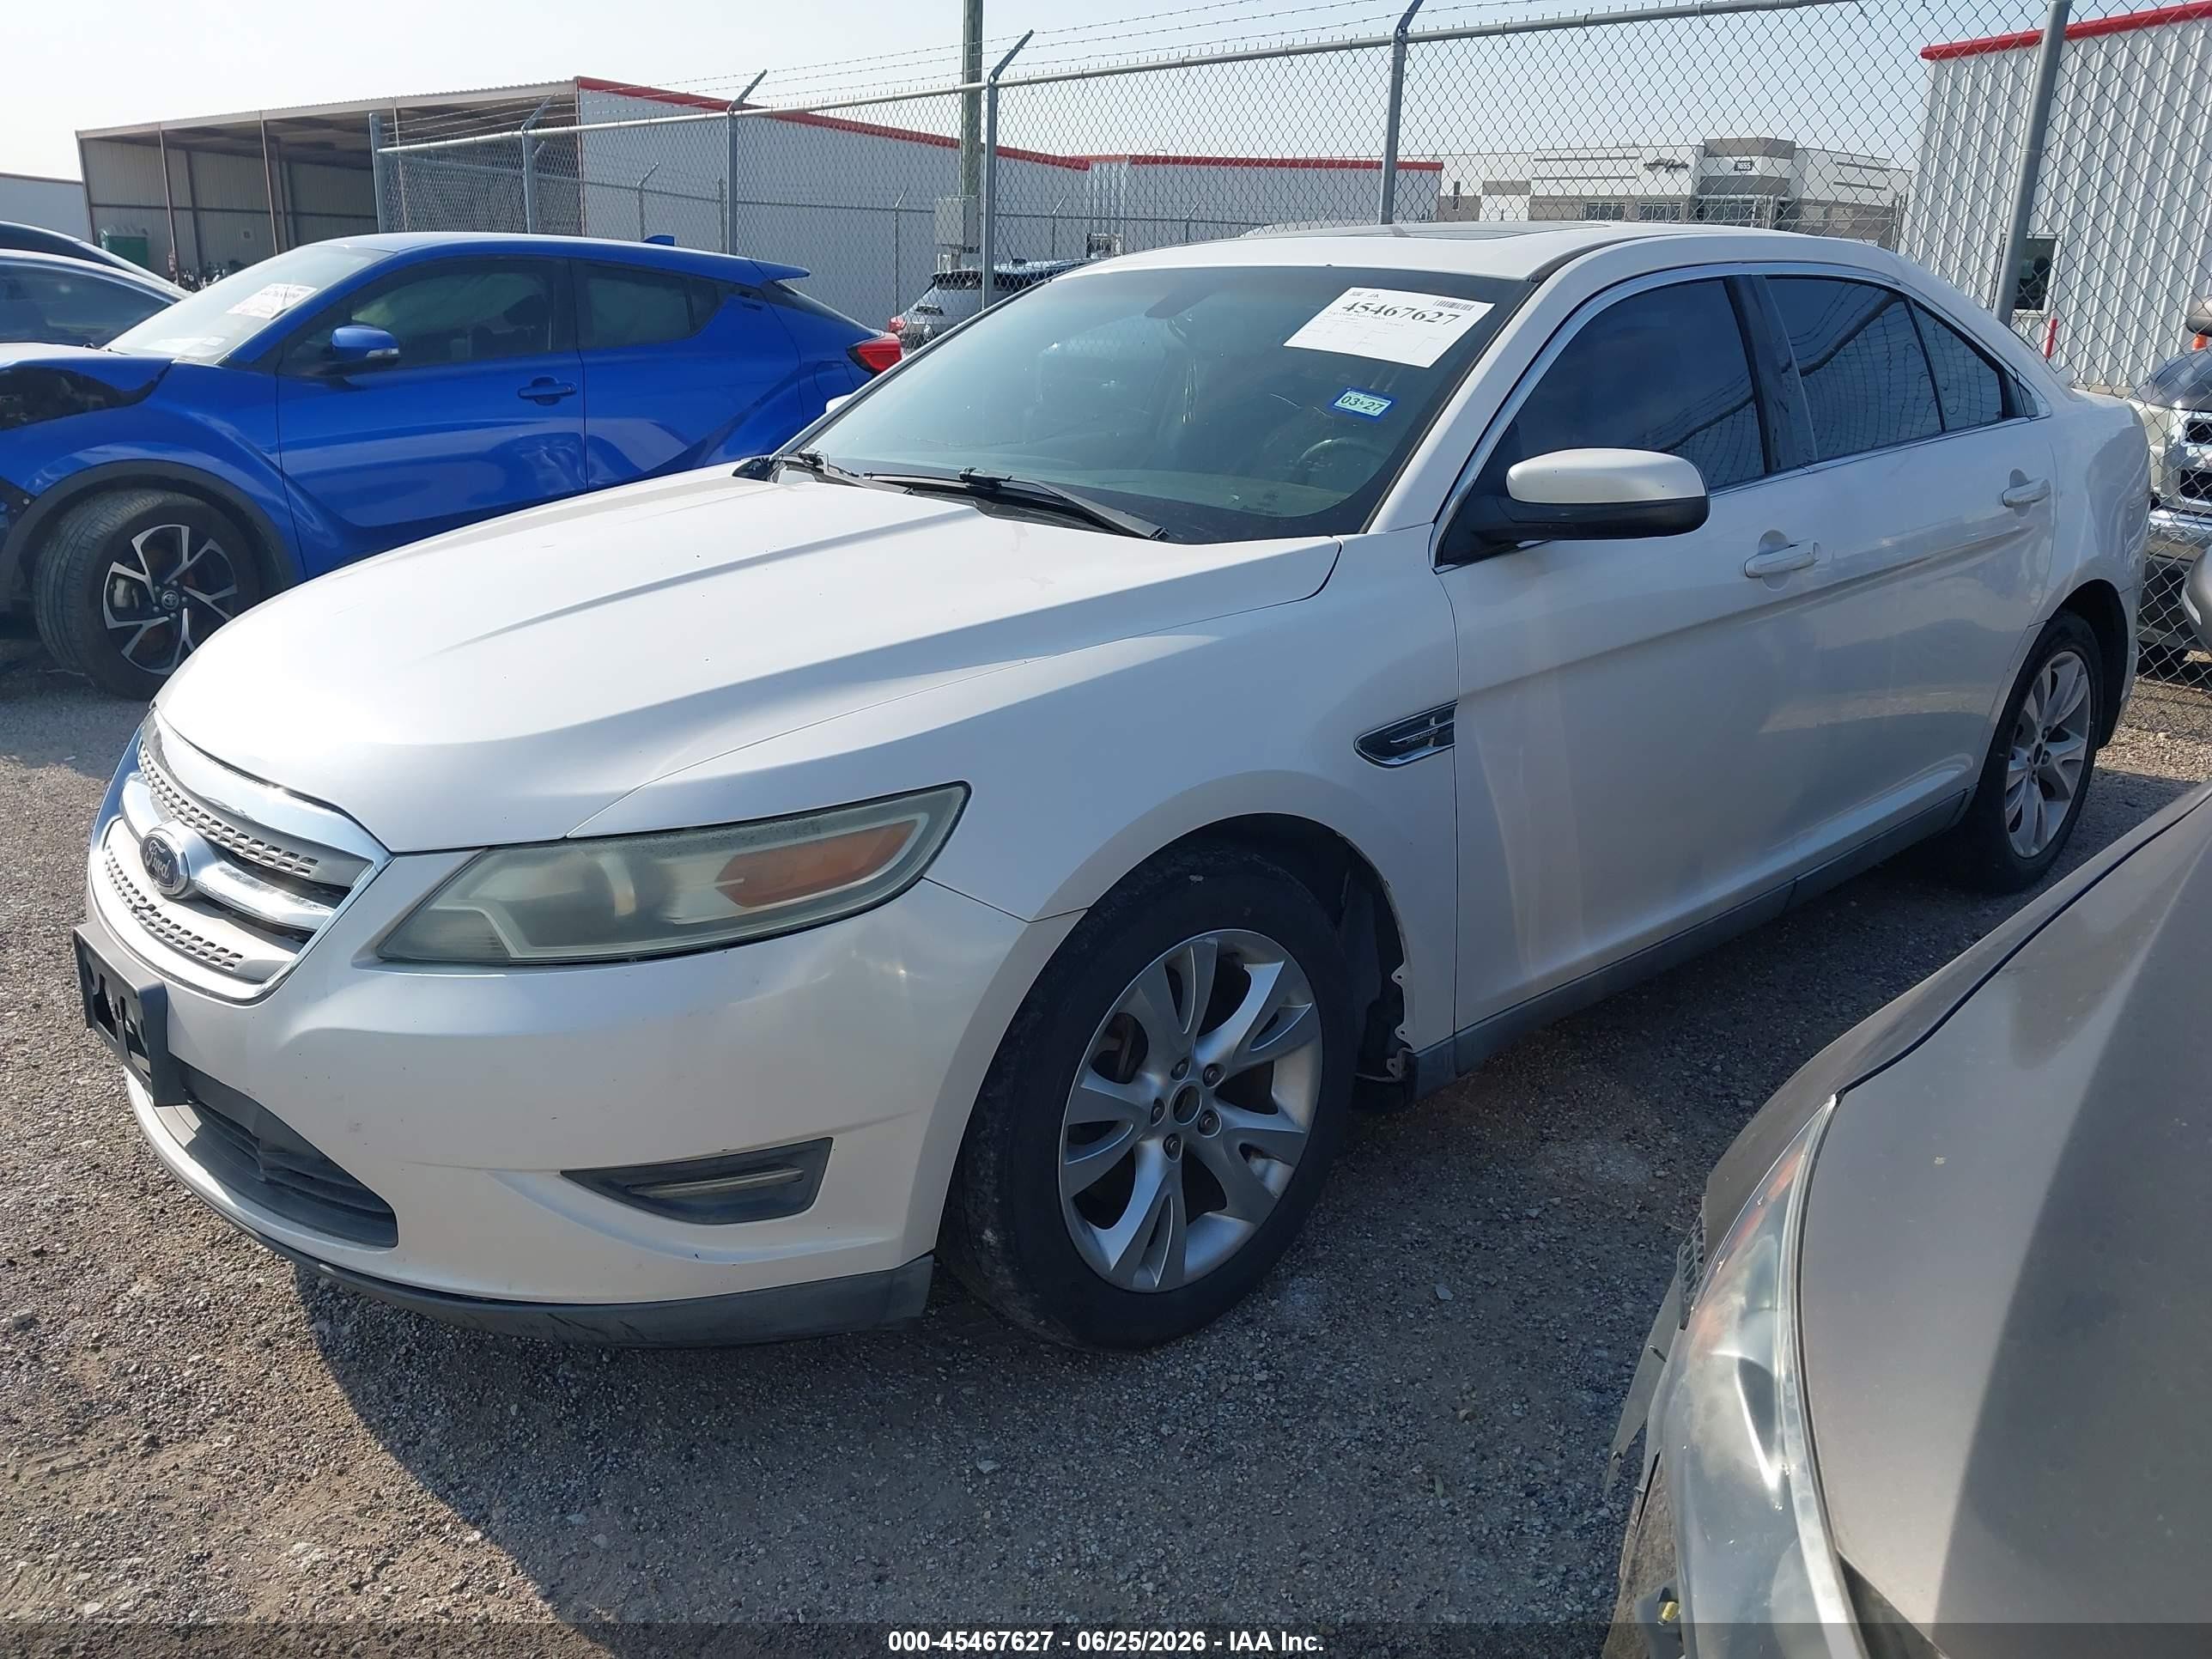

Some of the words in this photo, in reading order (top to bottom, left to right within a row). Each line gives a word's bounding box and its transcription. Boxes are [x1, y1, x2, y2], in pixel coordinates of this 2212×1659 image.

[1341, 301, 1462, 325] 45467627
[1340, 396, 1361, 406] 03
[1363, 401, 1385, 411] 27
[144, 840, 171, 879] Ford
